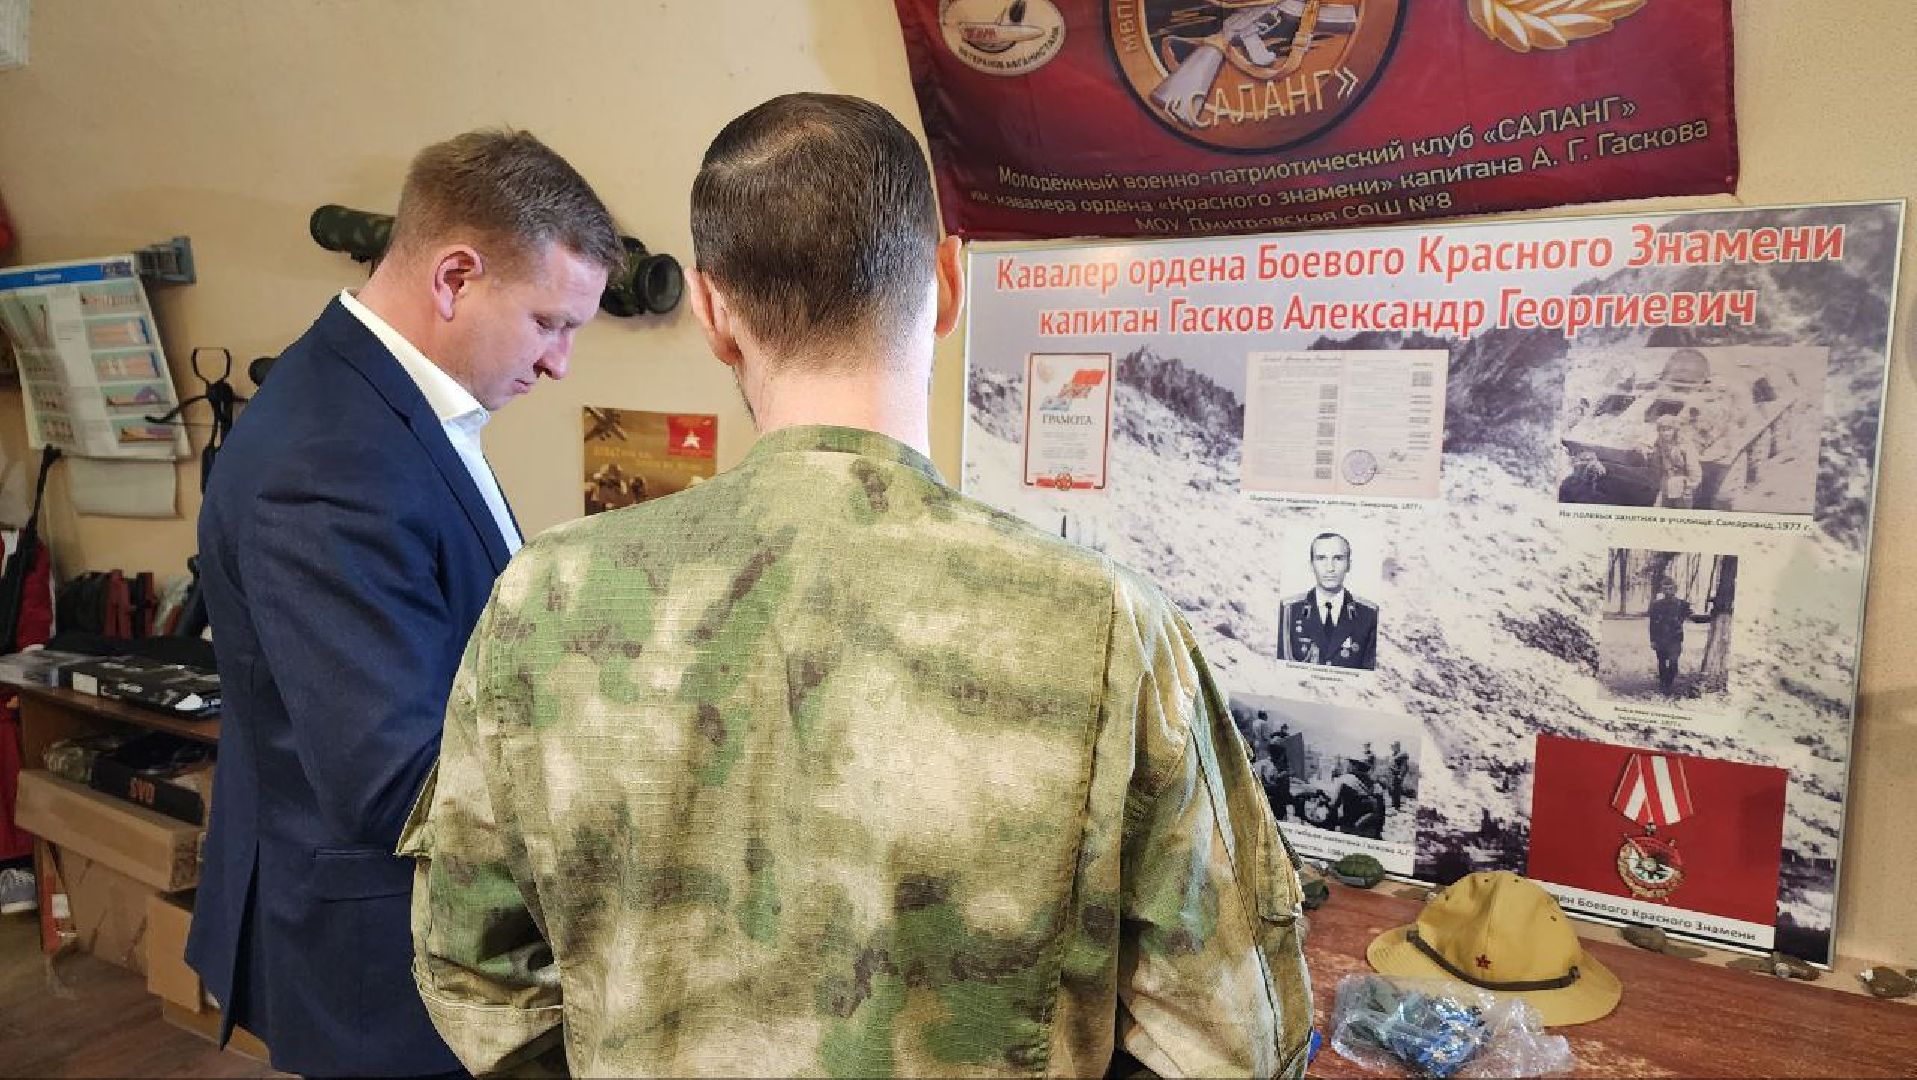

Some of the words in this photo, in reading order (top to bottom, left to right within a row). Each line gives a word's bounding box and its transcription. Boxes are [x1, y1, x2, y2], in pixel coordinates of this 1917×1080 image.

[1165, 67, 1359, 128] «САЛАНГ»
[996, 195, 1077, 214] кавалера
[1080, 200, 1153, 215] ордена
[1158, 191, 1272, 213] «Красного
[1277, 178, 1393, 205] знамени»
[1400, 156, 1524, 189] капитана
[1531, 147, 1559, 170] А.
[1567, 138, 1590, 162] Г.
[1598, 119, 1709, 156] Гаскова
[998, 166, 1120, 192] Молодёжный
[1124, 140, 1404, 189] военно-патриотический
[1412, 124, 1474, 157] клуб
[1483, 96, 1637, 142] «САЛАНГ»
[1134, 216, 1180, 232] МОУ
[1188, 210, 1338, 232] Дмитровская
[1342, 200, 1402, 219] СОШ
[1408, 192, 1453, 213] №8
[996, 256, 1119, 294] Кавалер
[1127, 253, 1246, 294] ордена
[1258, 243, 1406, 281] Боевого
[1418, 234, 1613, 284] Красного
[1626, 223, 1845, 267] Знамени
[1039, 308, 1159, 336] капитан
[1169, 298, 1275, 334] Гасков
[1283, 293, 1486, 338] Александр
[1499, 288, 1757, 338] Георгиевич
[1042, 414, 1093, 426] ГРАМОТА
[1577, 897, 1628, 917] Боевого
[1632, 907, 1693, 930] Красного
[1695, 921, 1757, 941] Знамени
